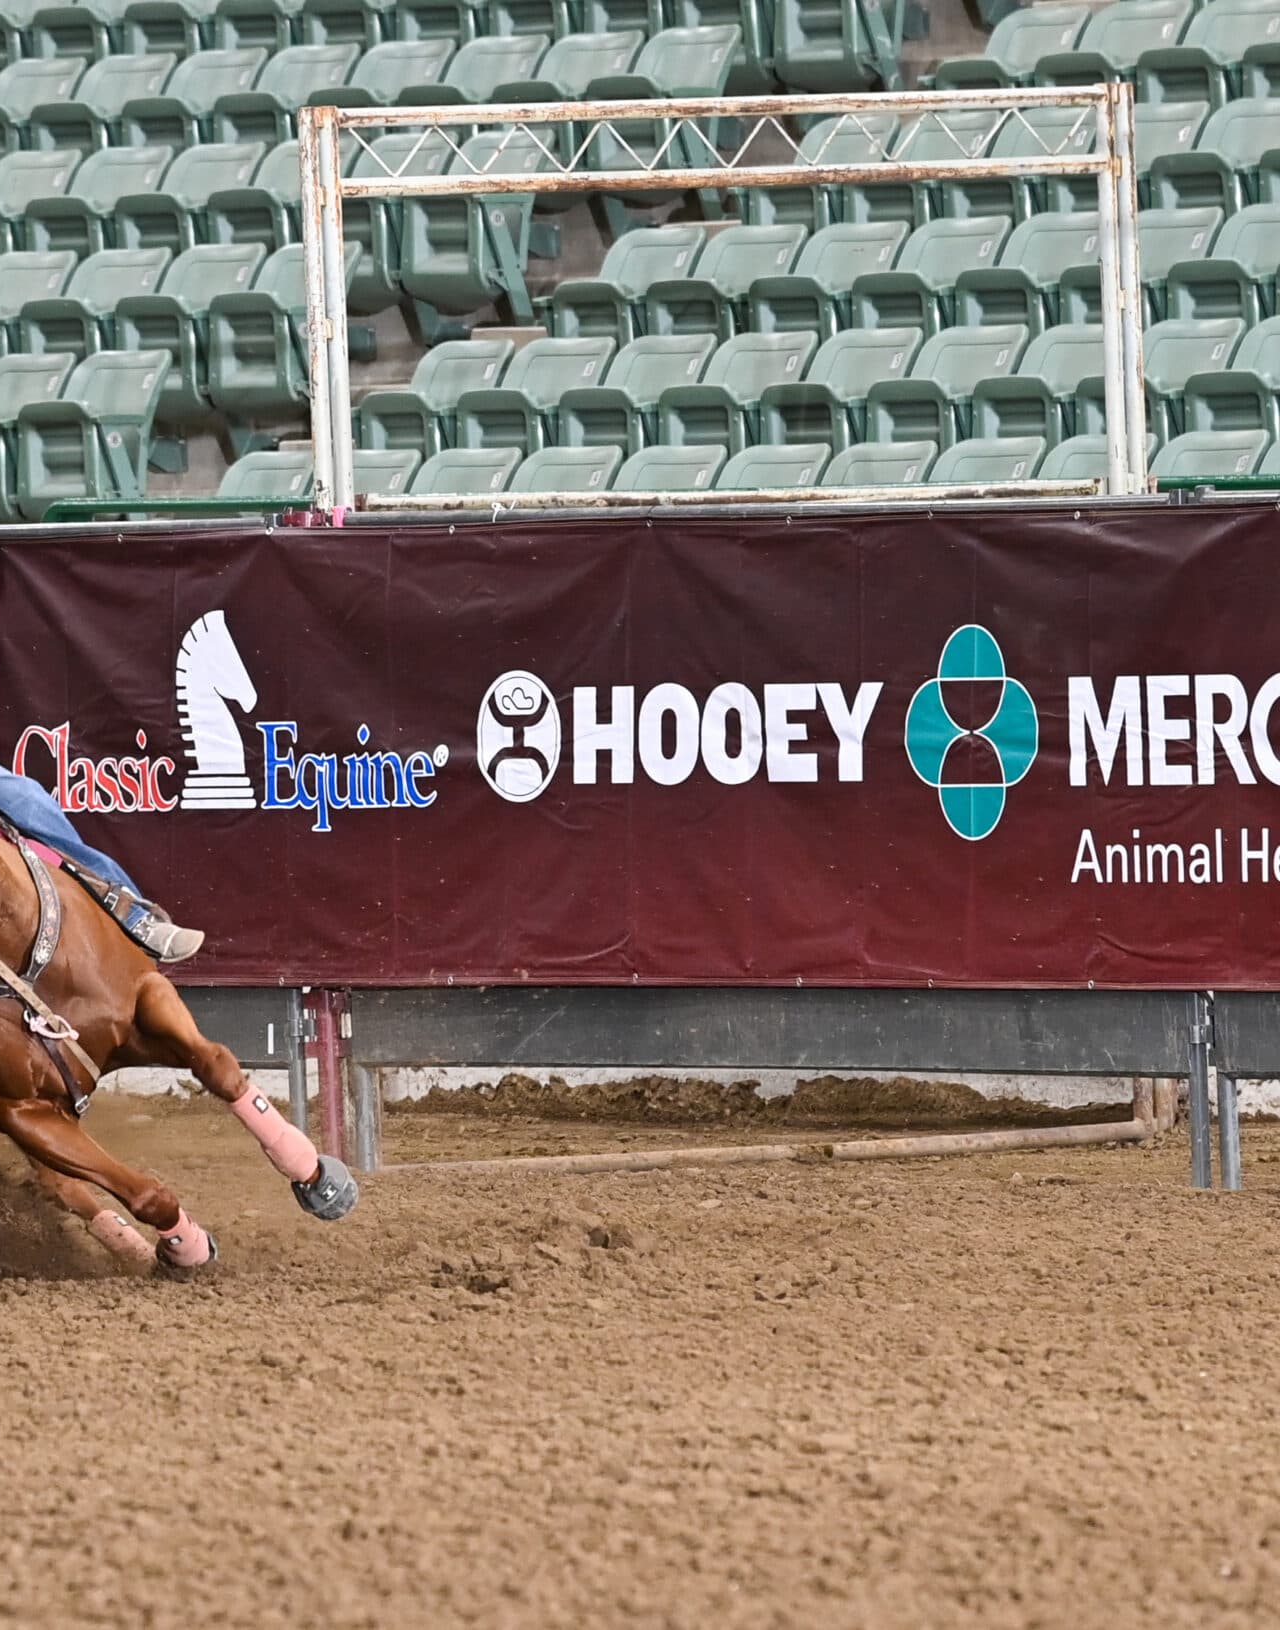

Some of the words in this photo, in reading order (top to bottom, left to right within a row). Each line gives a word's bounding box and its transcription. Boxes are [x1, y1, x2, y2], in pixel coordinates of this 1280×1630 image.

[12, 720, 179, 813] Classic
[256, 720, 438, 831] Equine
[573, 682, 884, 786] HOOEY
[1070, 828, 1224, 884] Animal
